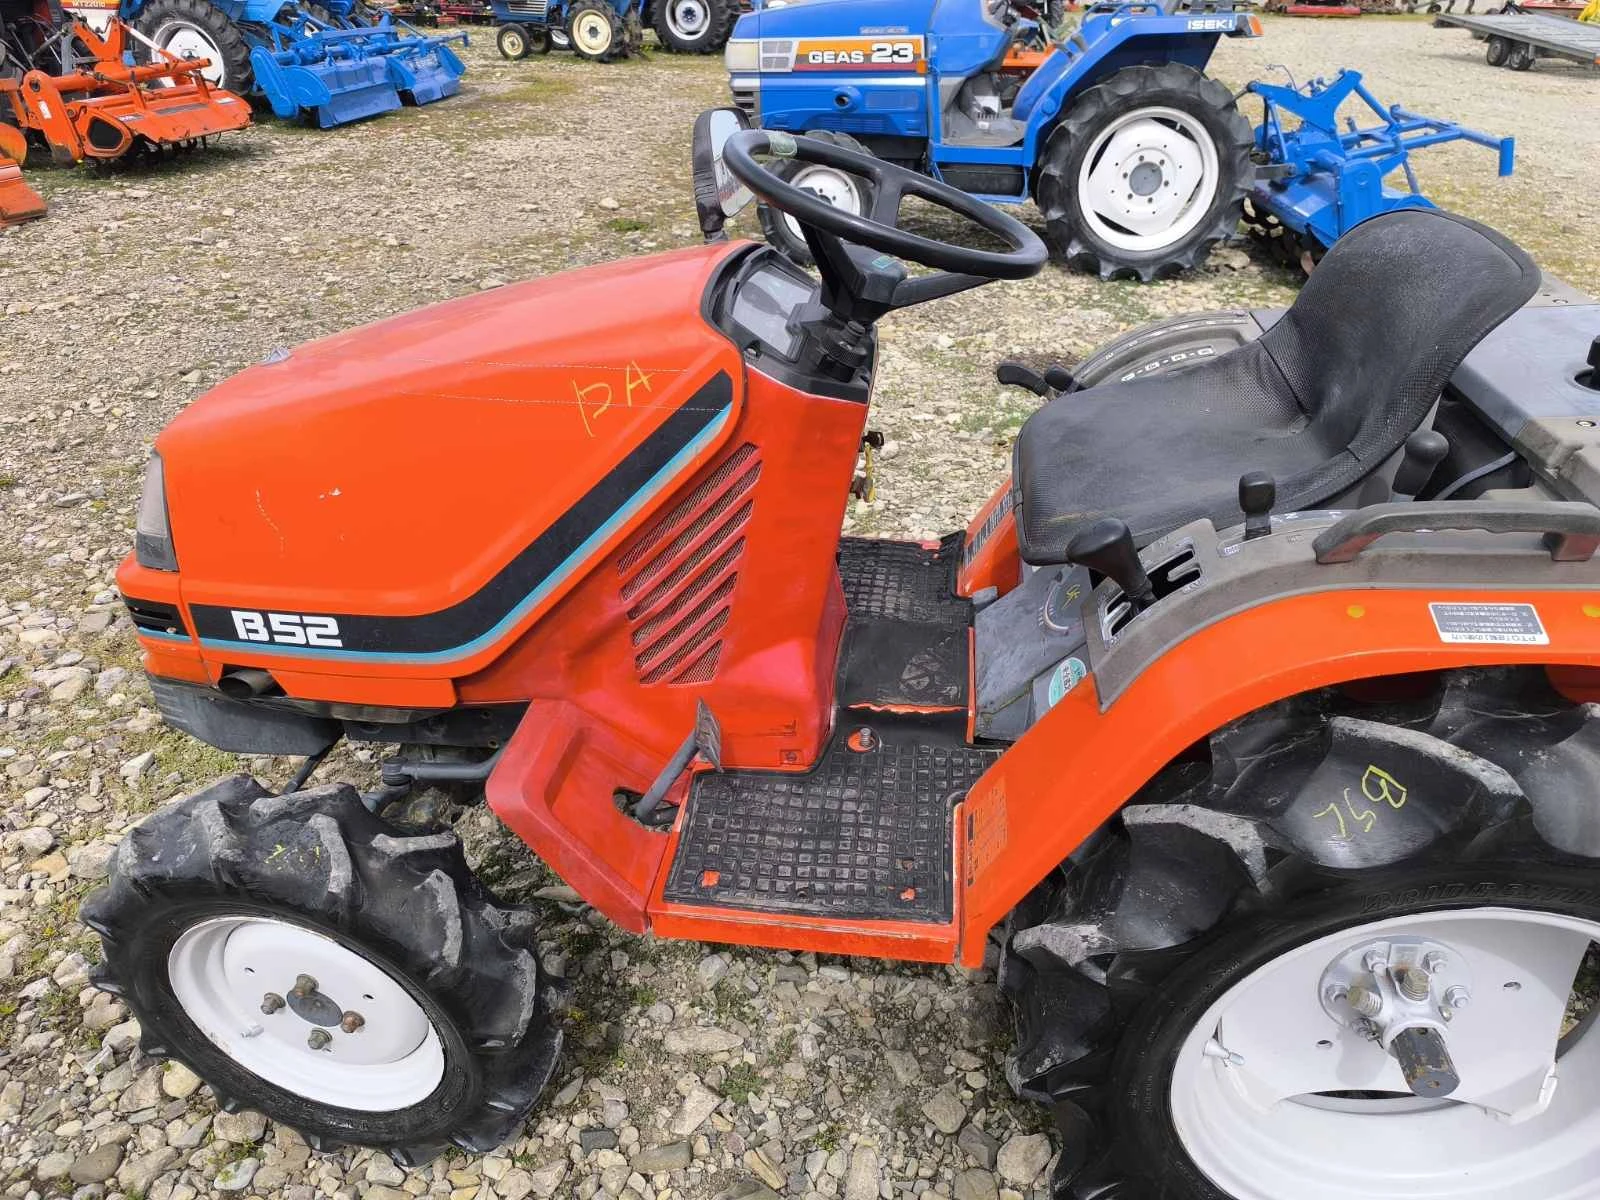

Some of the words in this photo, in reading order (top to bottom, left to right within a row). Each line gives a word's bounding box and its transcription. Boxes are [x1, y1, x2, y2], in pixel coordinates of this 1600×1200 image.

[1187, 19, 1233, 30] ISEKI
[808, 51, 864, 64] GEAS
[871, 43, 914, 64] 23
[231, 610, 343, 647] B52
